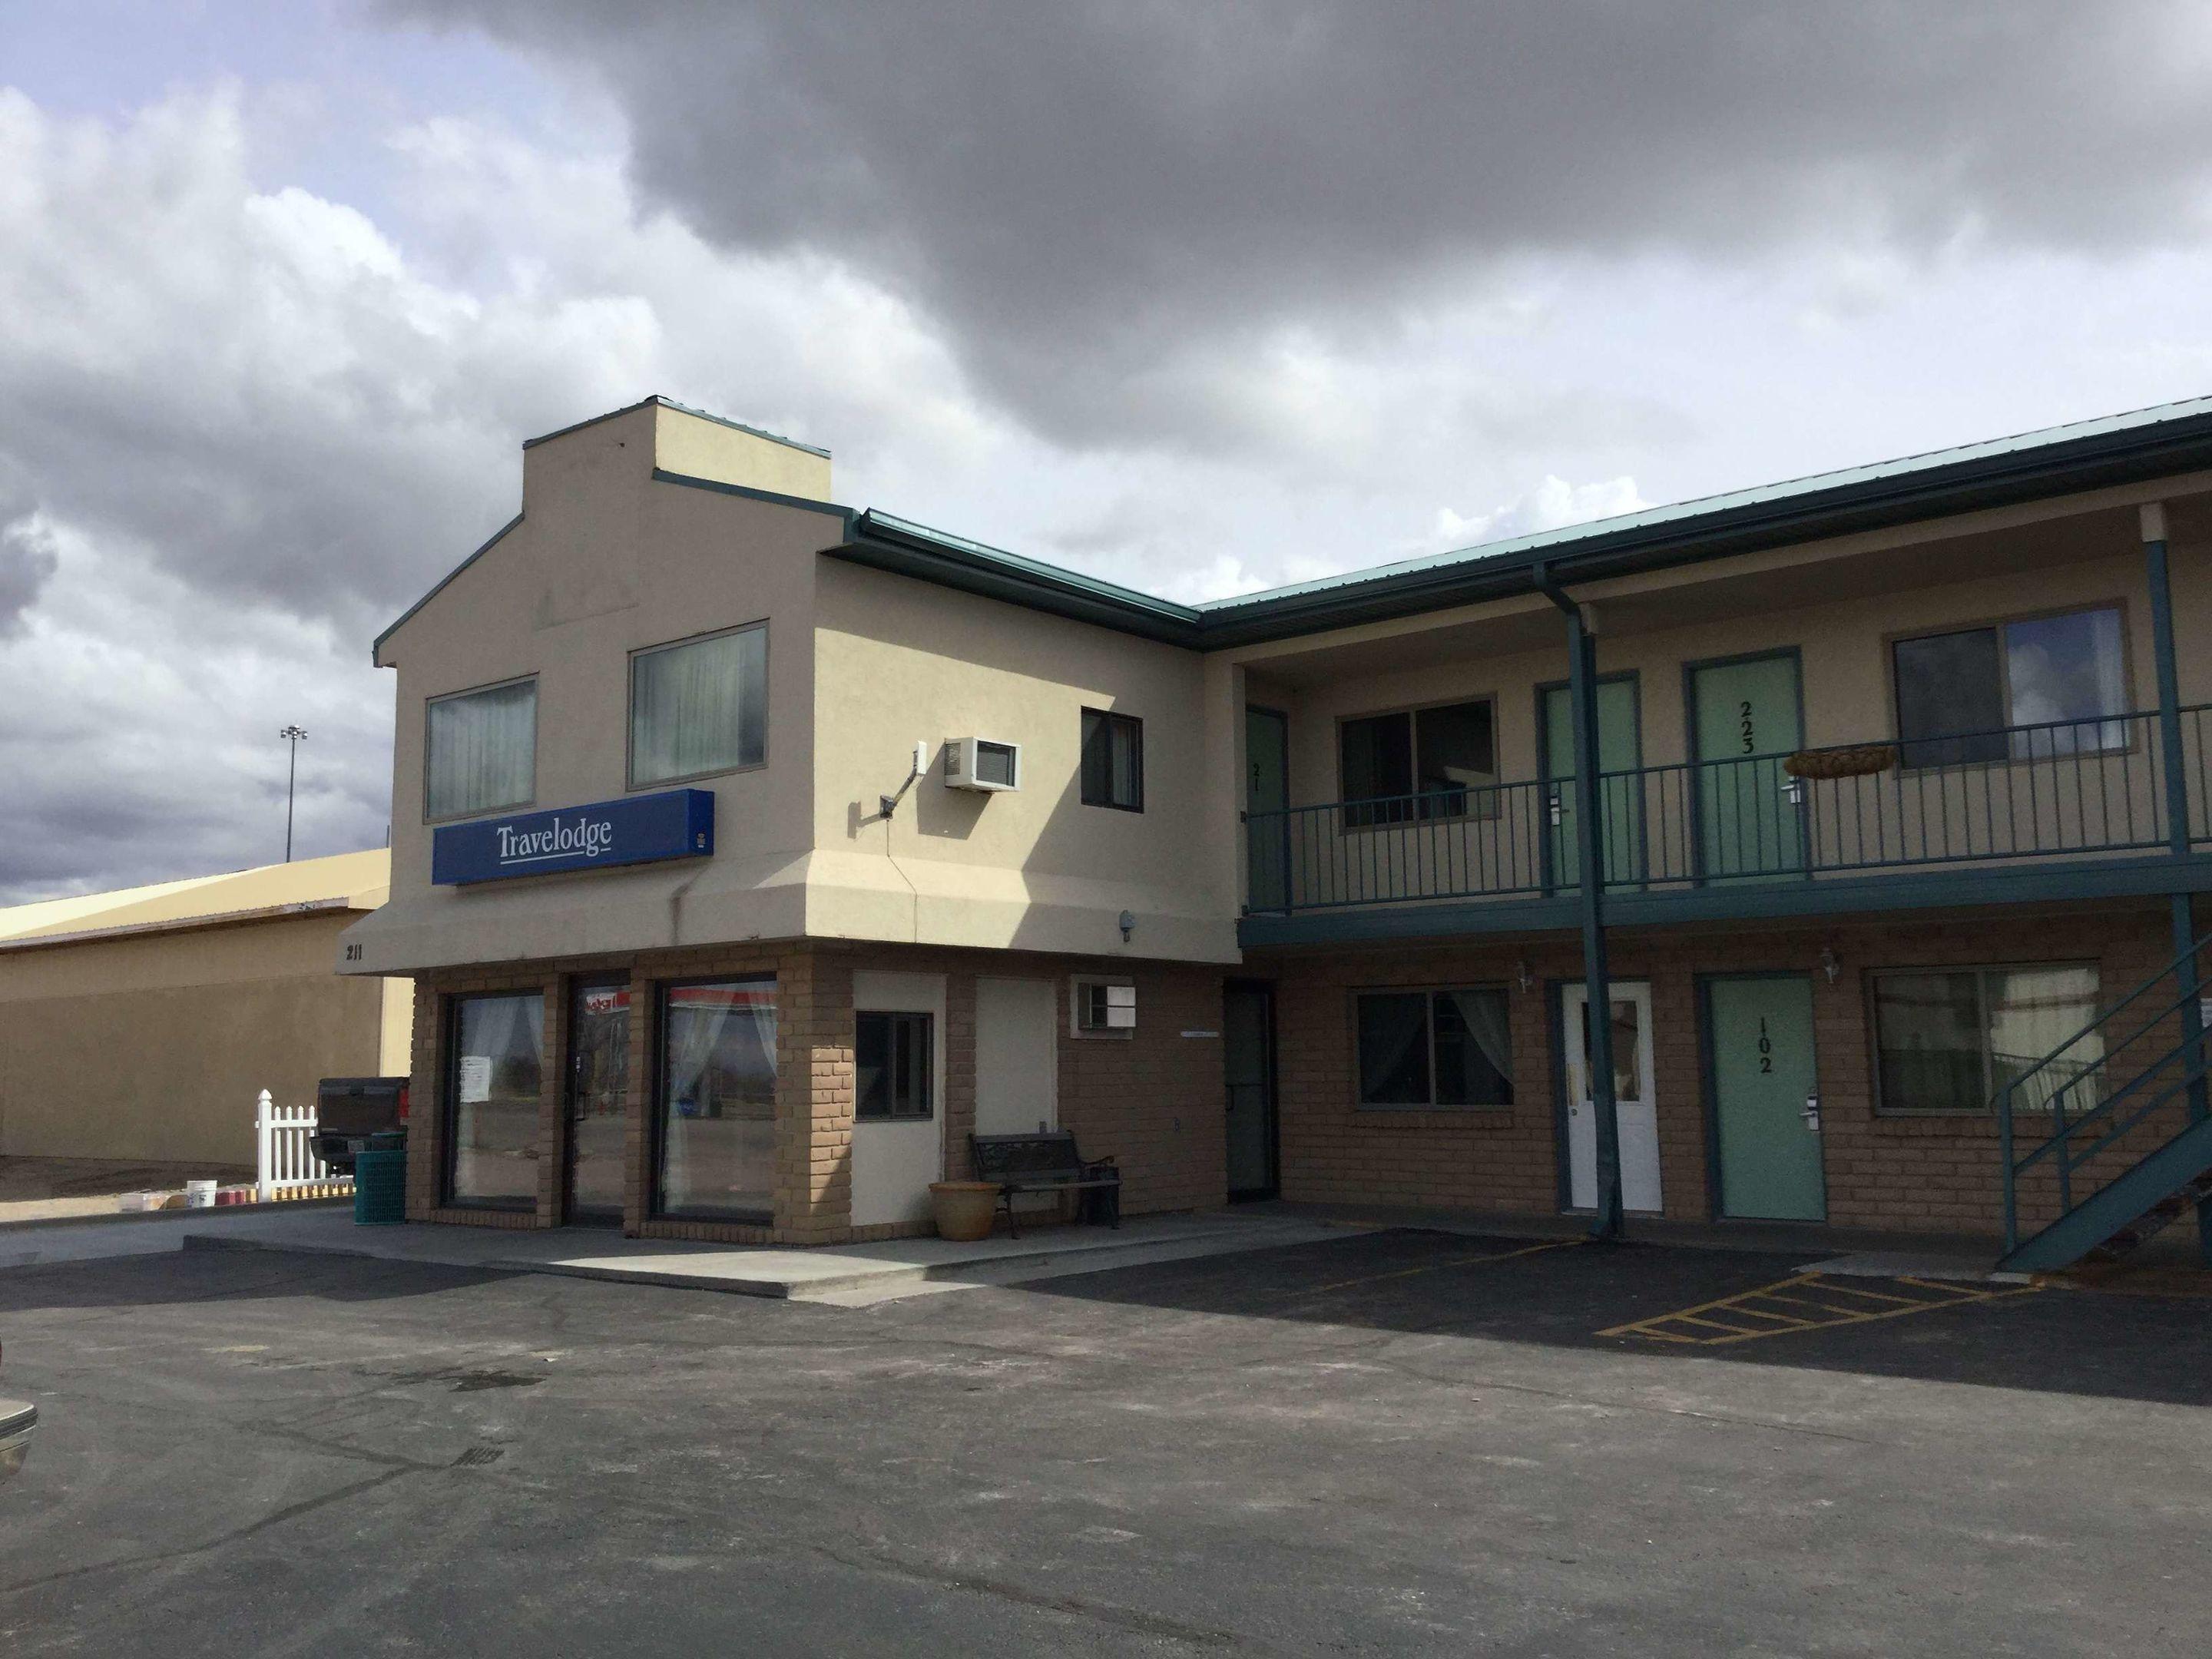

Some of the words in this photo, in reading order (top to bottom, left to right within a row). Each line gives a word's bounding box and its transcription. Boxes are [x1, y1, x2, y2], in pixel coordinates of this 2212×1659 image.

[1740, 700, 1754, 754] 223
[496, 816, 613, 858] Travelodge
[346, 944, 363, 961] 211
[1758, 1016, 1773, 1074] 102
